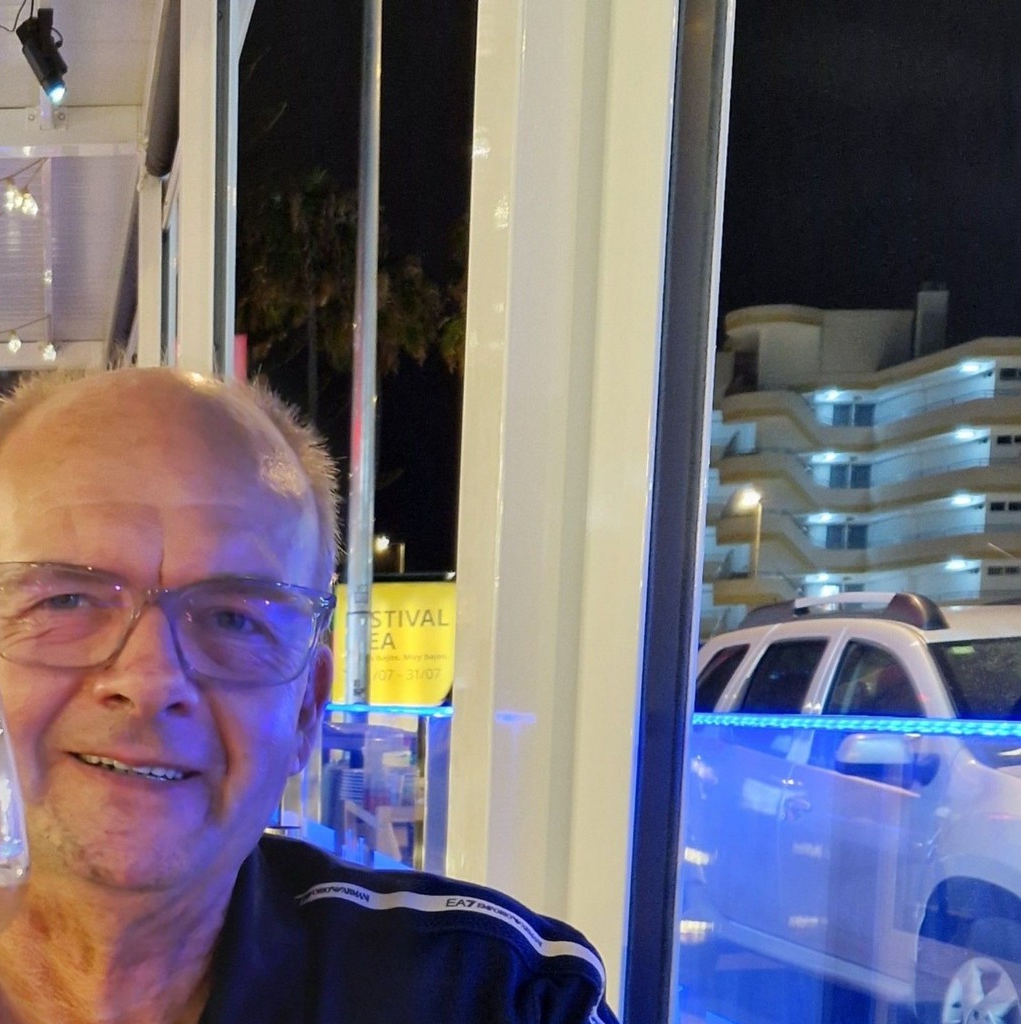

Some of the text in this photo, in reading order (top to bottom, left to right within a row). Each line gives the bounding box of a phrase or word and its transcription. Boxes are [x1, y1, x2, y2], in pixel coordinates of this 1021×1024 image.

[371, 609, 449, 628] STIVAL
[371, 632, 396, 650] EA
[445, 898, 476, 908] EA7
